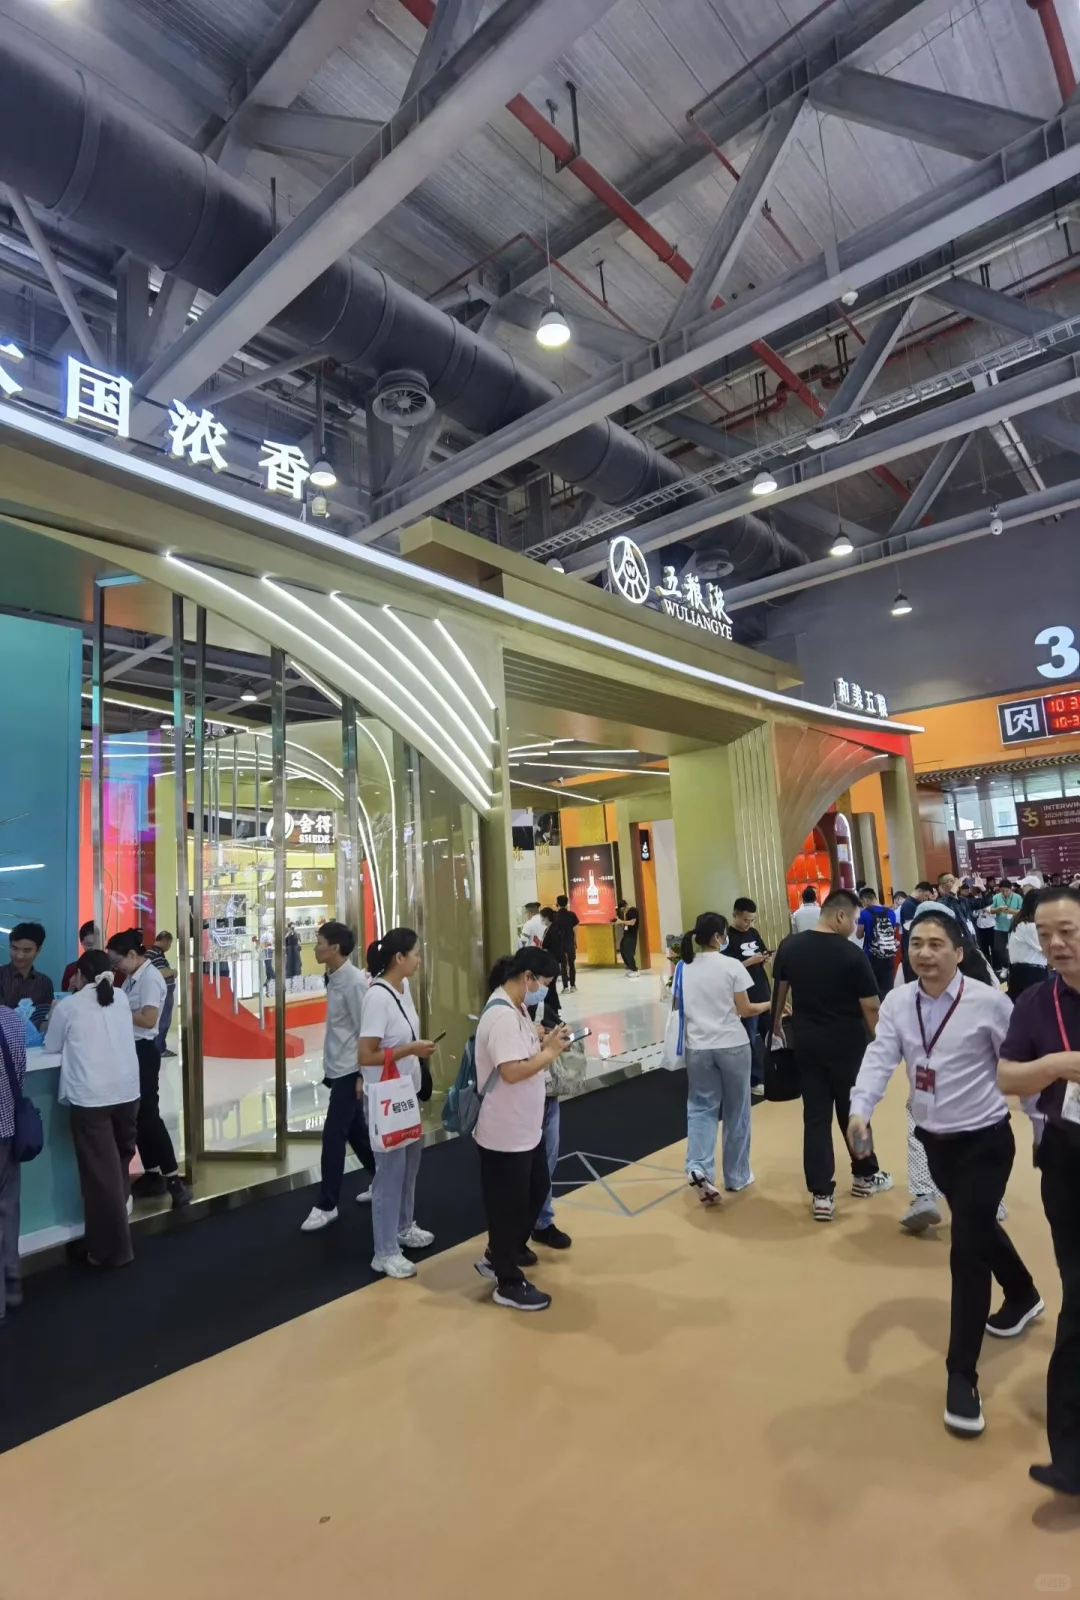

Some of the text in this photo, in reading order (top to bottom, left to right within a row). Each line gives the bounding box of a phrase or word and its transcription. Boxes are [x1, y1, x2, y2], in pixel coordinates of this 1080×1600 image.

[655, 565, 733, 625] 五粮液
[662, 598, 733, 640] WULIANGYE
[1034, 625, 1080, 679] 3
[299, 813, 332, 834] 舍得
[299, 834, 331, 844] SHEDE
